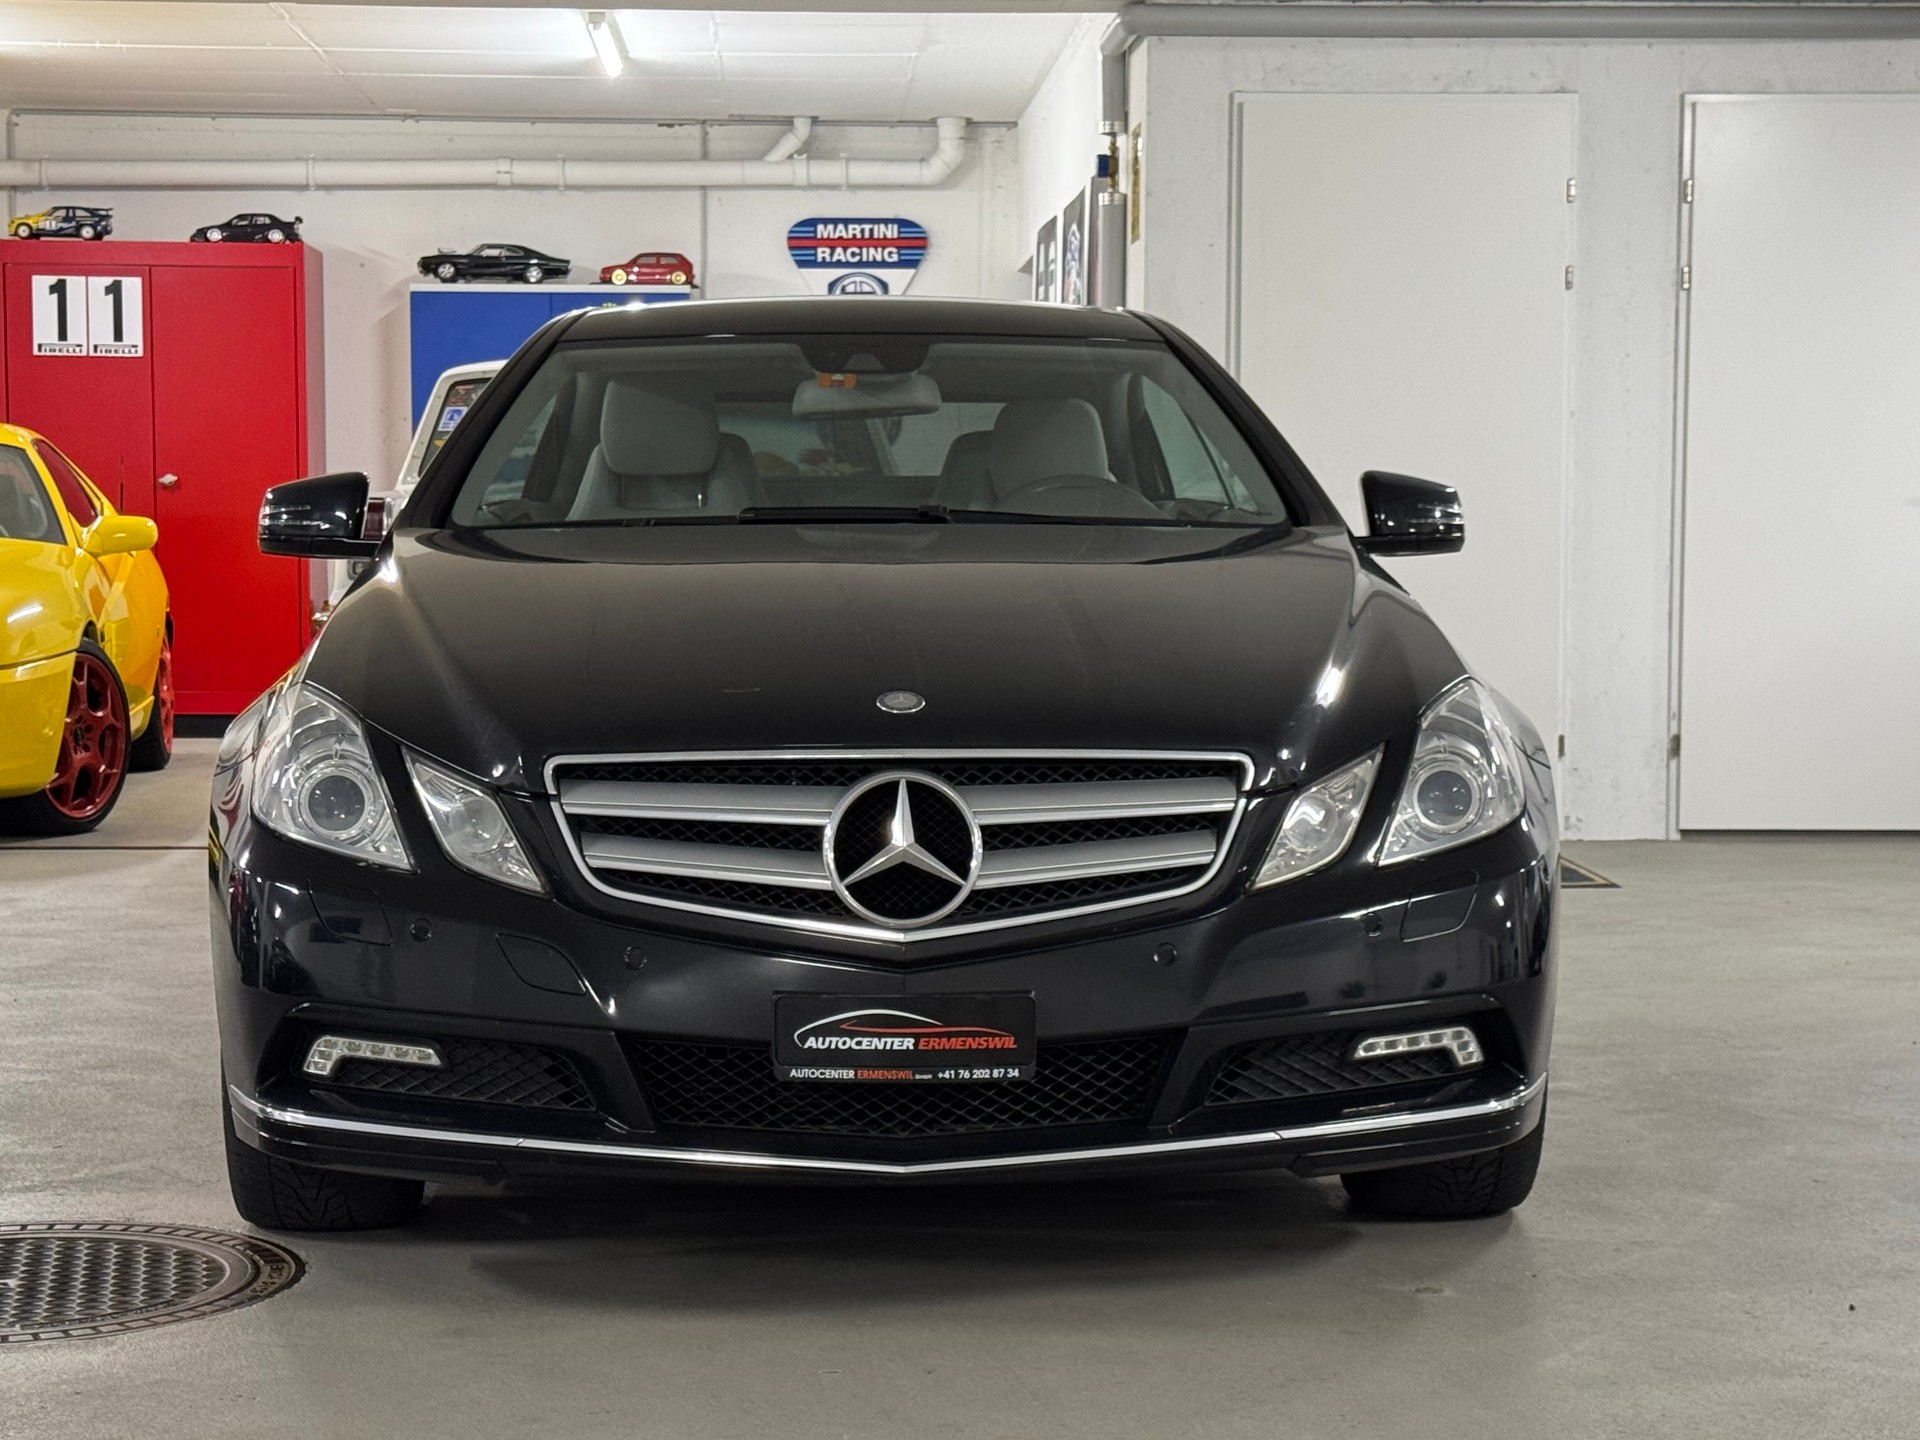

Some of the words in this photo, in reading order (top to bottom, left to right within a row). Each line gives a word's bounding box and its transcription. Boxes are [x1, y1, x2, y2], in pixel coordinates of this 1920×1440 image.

[816, 223, 899, 239] MARTINI
[816, 247, 899, 263] RACING
[37, 343, 84, 354] PIRELLI
[93, 344, 139, 355] PIRELLI
[803, 1036, 915, 1051] AUTOCENTER
[918, 1036, 1018, 1050] ERMENSWIL
[789, 1068, 856, 1079] AUTOCENTER
[857, 1069, 914, 1080] ERMENSWIL
[937, 1069, 956, 1079] +41
[957, 1069, 971, 1079] 76
[972, 1068, 991, 1079] 202
[992, 1068, 1005, 1078] 87
[1006, 1068, 1020, 1078] 34
